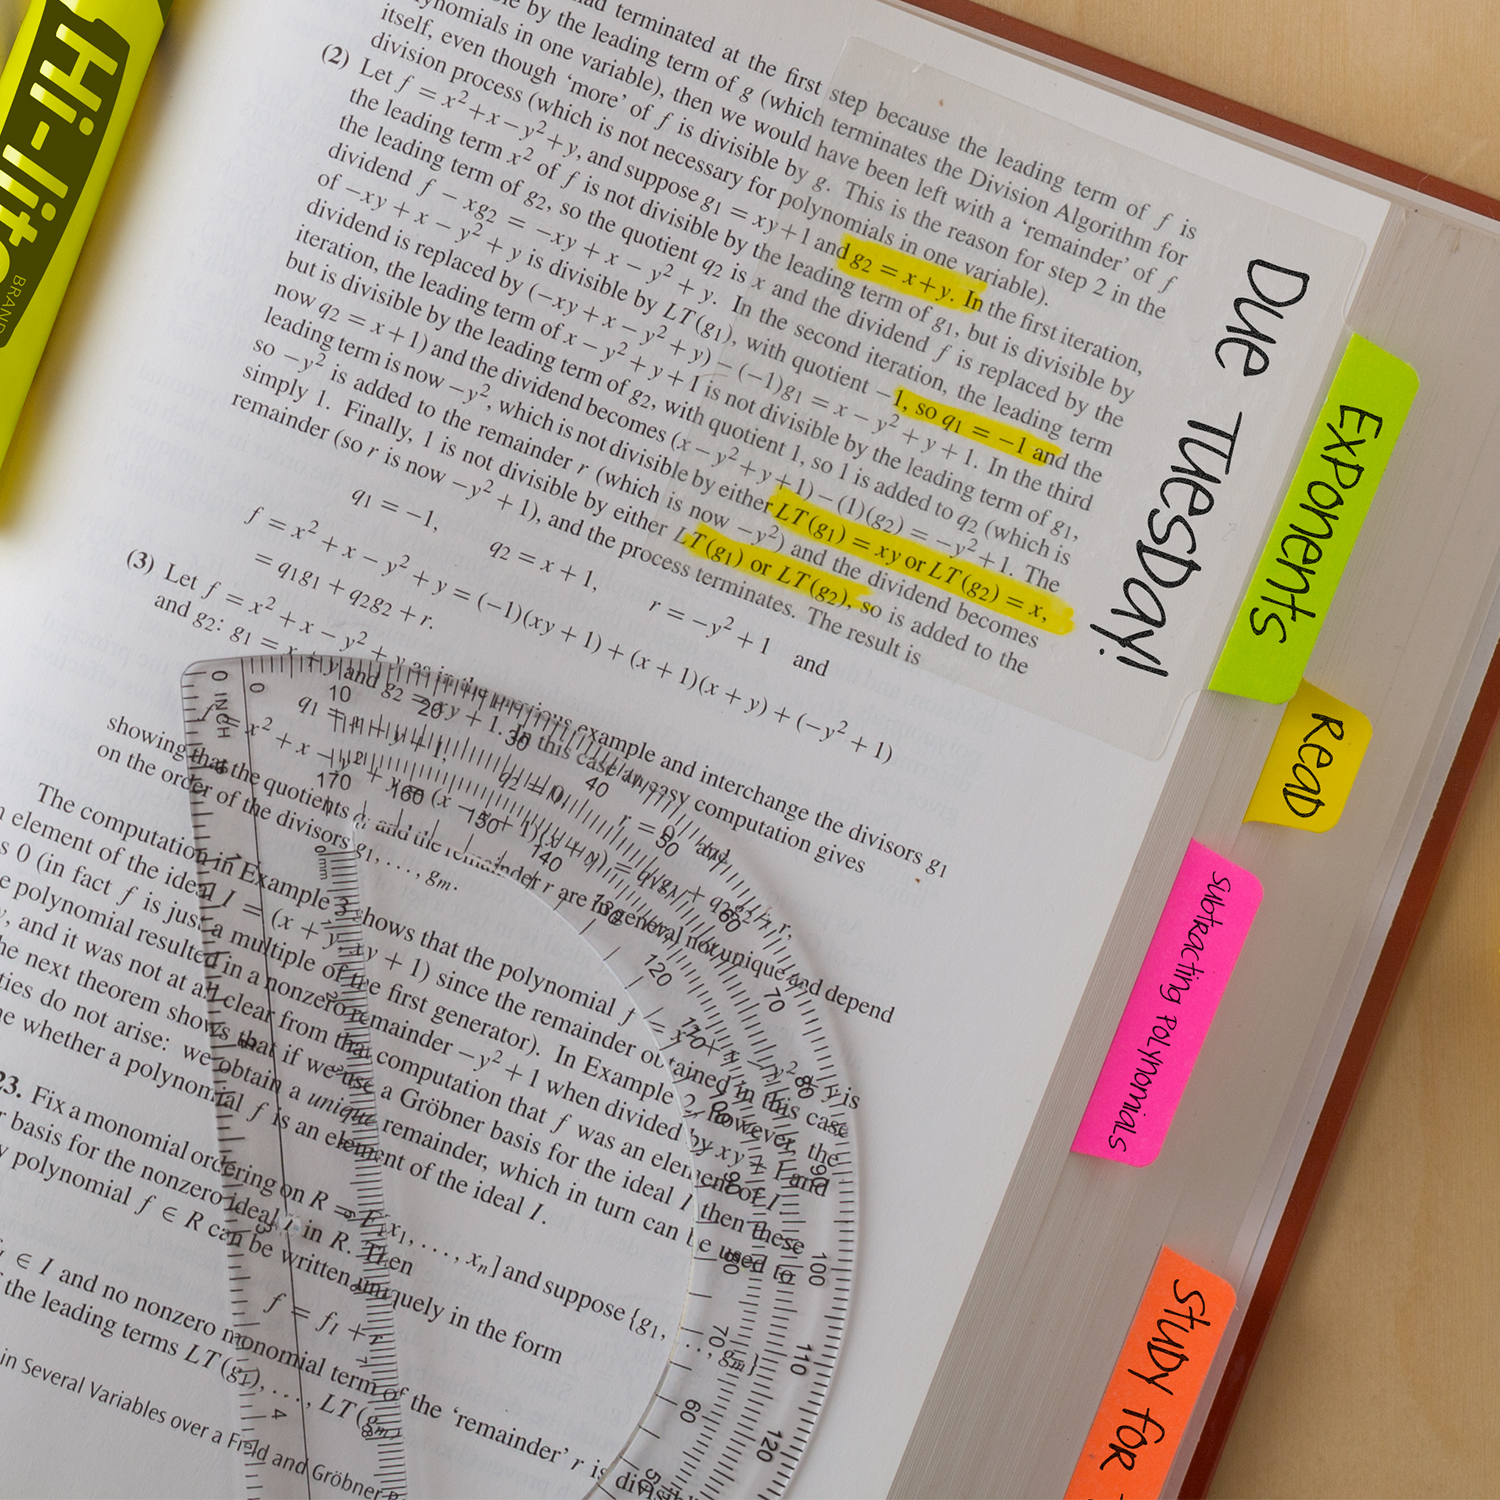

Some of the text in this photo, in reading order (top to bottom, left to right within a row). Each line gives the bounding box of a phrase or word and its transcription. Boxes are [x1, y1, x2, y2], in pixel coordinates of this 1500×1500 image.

[321, 43, 394, 86] (2) Let
[614, 3, 717, 54] terminated
[721, 47, 741, 64] at
[747, 53, 777, 78] the
[783, 66, 823, 96] first
[828, 88, 868, 117] step
[875, 101, 950, 145] because
[958, 135, 988, 159] the
[995, 147, 1066, 194] leading
[1073, 180, 1117, 210] term
[1125, 203, 1152, 221] of
[1152, 212, 1174, 232] f
[1179, 218, 1197, 244] is
[242, 365, 413, 445] simply 1. Finally,
[807, 606, 921, 665] The result is
[328, 685, 351, 702] 10
[316, 771, 351, 790] 170
[585, 776, 610, 797] 40
[31, 1085, 65, 1112] Fix
[67, 1105, 81, 1120] a
[83, 1106, 187, 1162] monomial
[10, 1151, 133, 1206] polynomial
[808, 1251, 828, 1287] 100
[708, 1324, 729, 1348] 70
[790, 1343, 813, 1376] 110
[0, 1346, 18, 1370] in
[21, 1357, 86, 1394] Several
[90, 1380, 167, 1424] Variables
[170, 1415, 210, 1439] over
[211, 1429, 223, 1445] a
[679, 1399, 701, 1424] 60
[756, 1429, 783, 1463] 120
